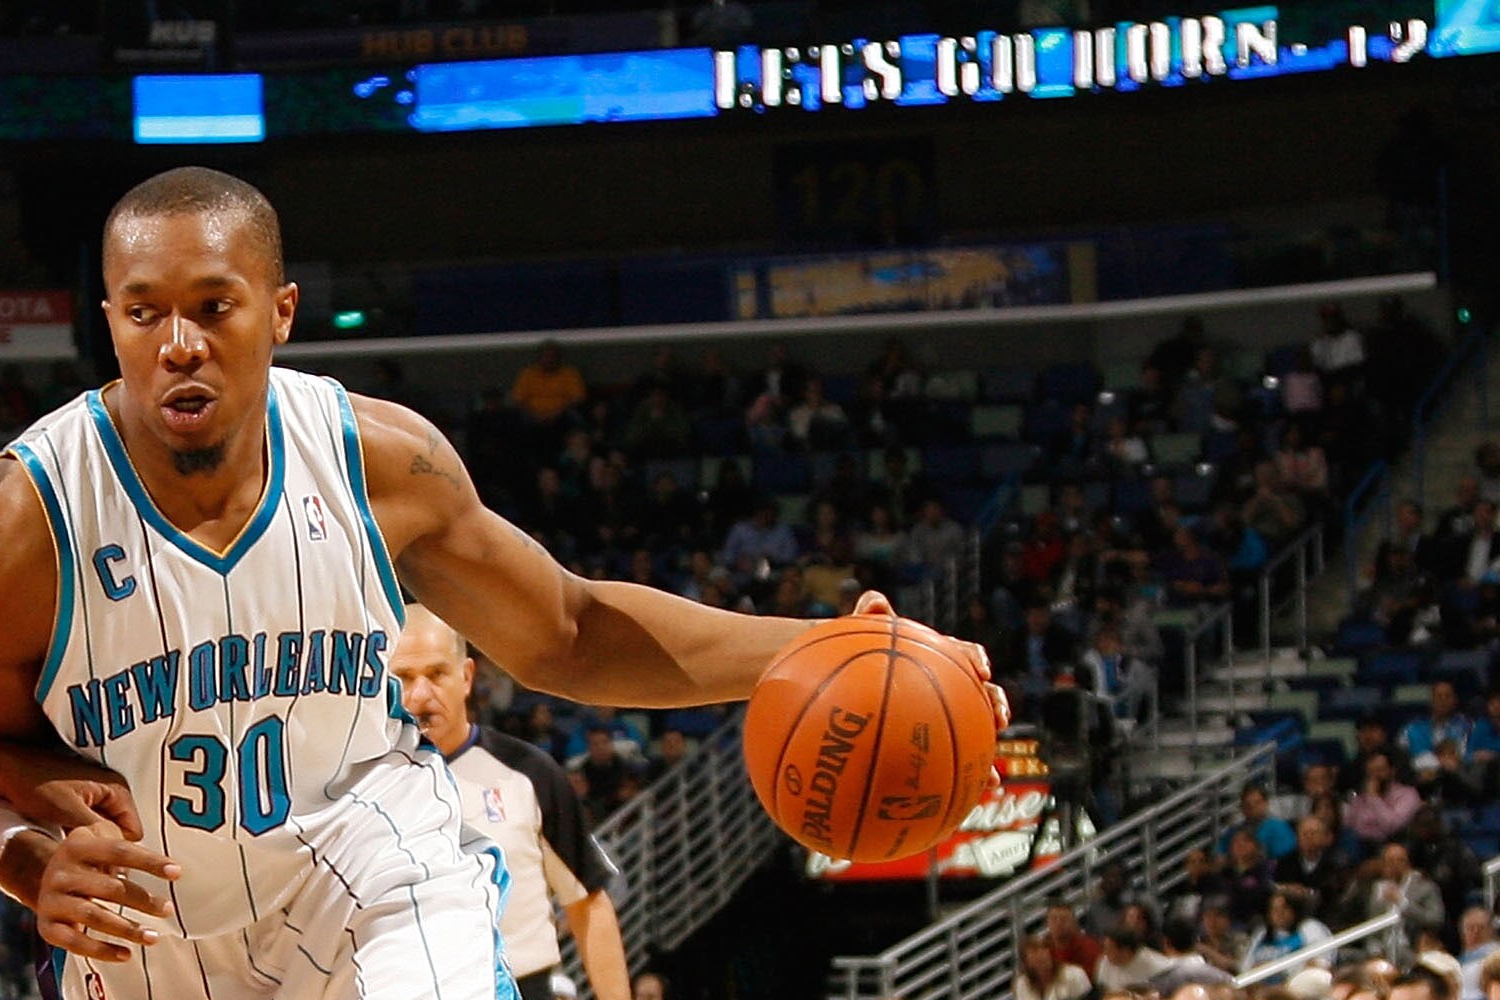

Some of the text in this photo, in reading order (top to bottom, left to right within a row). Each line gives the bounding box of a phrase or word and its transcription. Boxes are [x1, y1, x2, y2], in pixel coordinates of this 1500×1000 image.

[362, 24, 529, 58] HUB CLUB
[92, 543, 137, 602] C
[66, 630, 388, 748] NEW ORLEANS
[165, 714, 292, 838] 30
